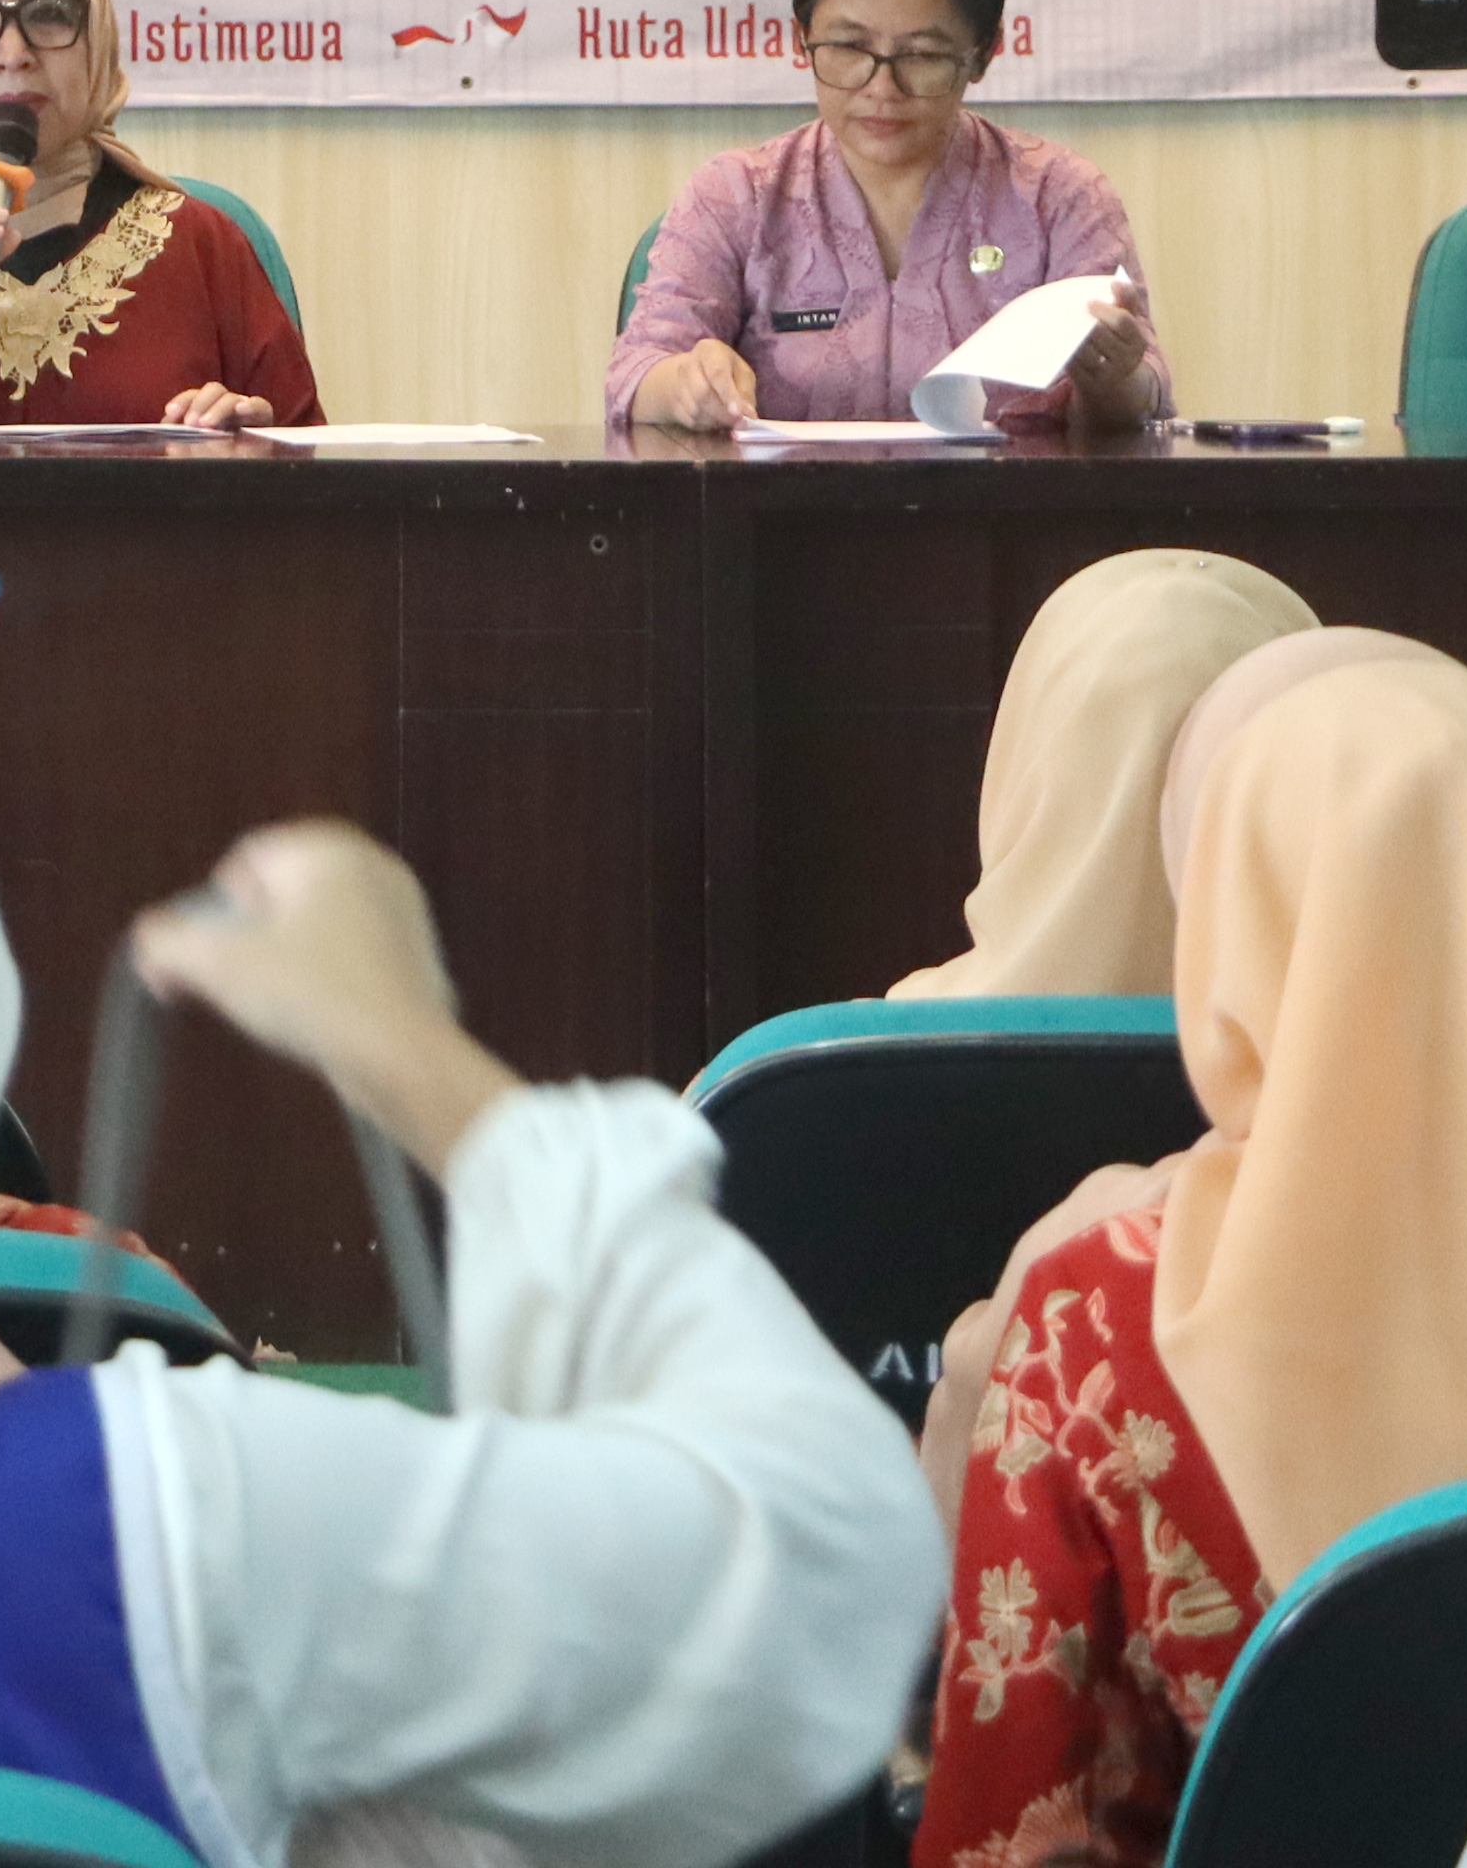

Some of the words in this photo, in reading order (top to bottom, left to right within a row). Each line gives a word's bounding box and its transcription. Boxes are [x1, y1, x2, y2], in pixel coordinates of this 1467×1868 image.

[129, 8, 344, 63] Istimewa
[577, 5, 685, 61] Kuta
[797, 312, 837, 324] INTAN
